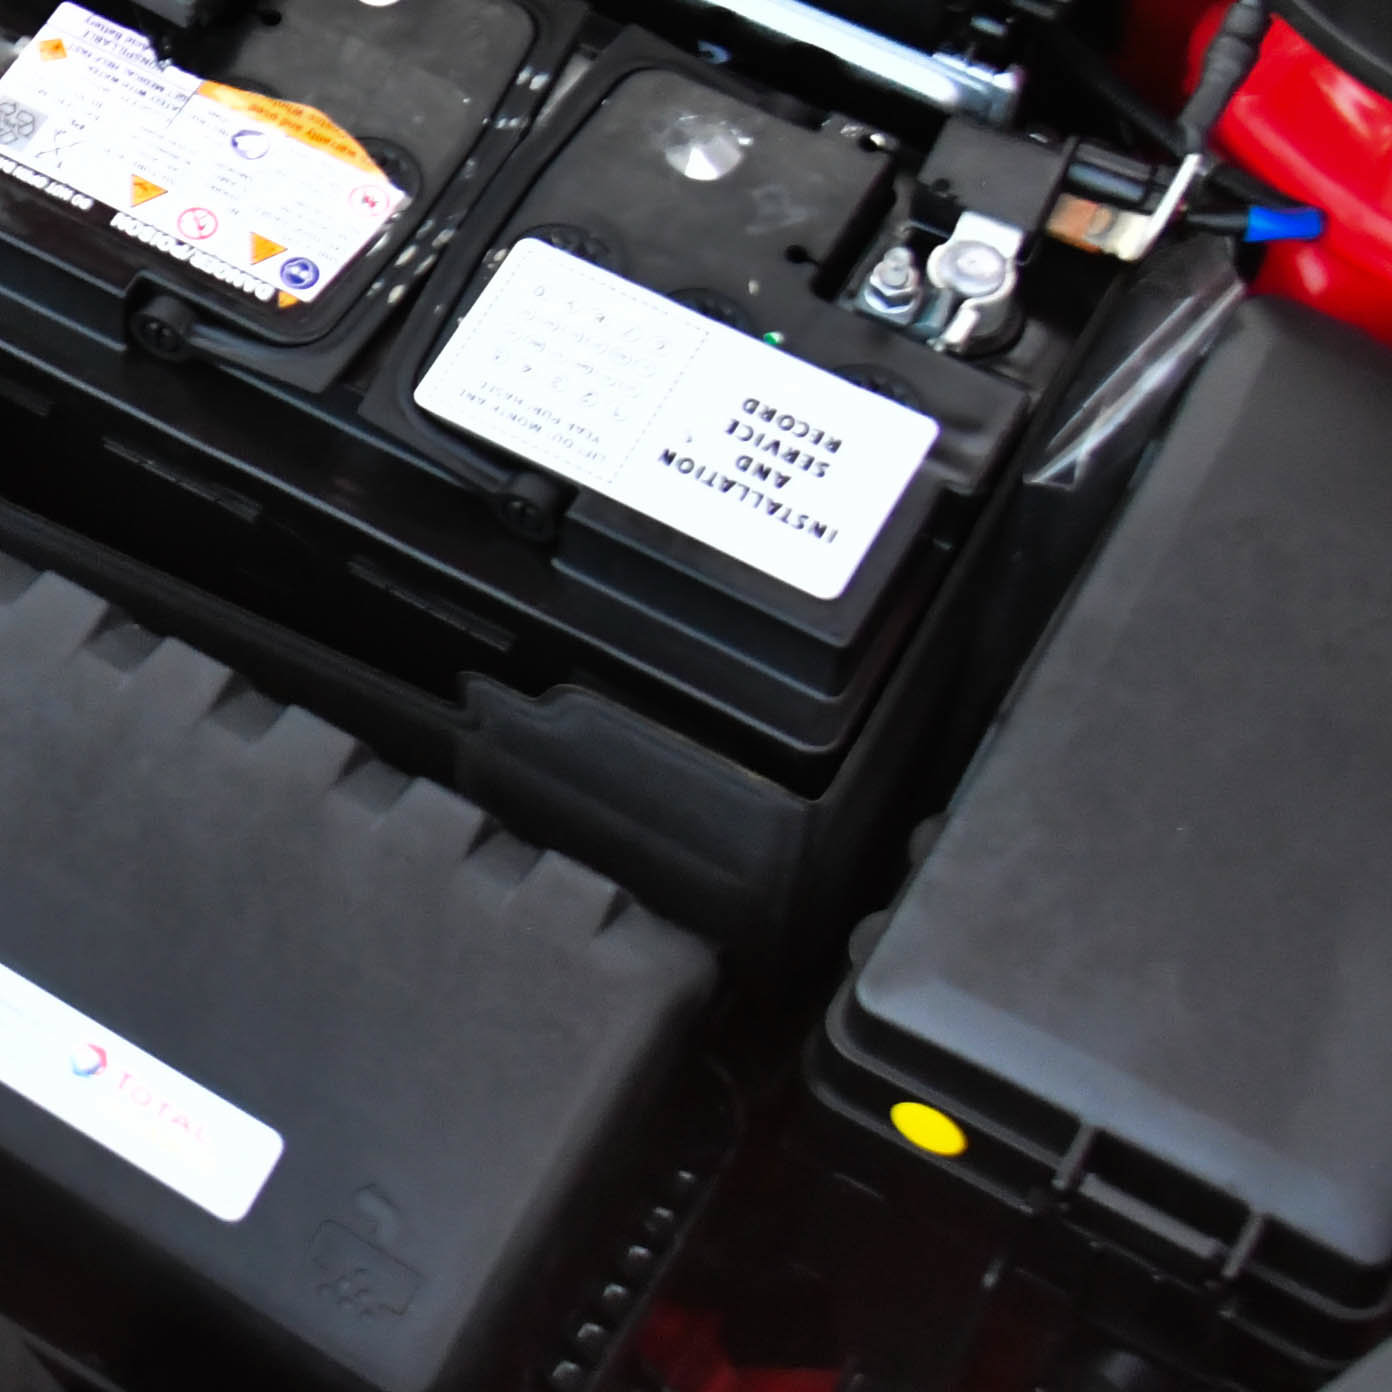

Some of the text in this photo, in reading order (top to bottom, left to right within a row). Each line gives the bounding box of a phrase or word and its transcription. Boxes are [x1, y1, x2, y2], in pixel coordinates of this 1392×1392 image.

[724, 417, 832, 479] SERVICE
[741, 396, 844, 454] RECORD
[658, 446, 838, 544] INSTALLATION
[734, 454, 792, 489] AND
